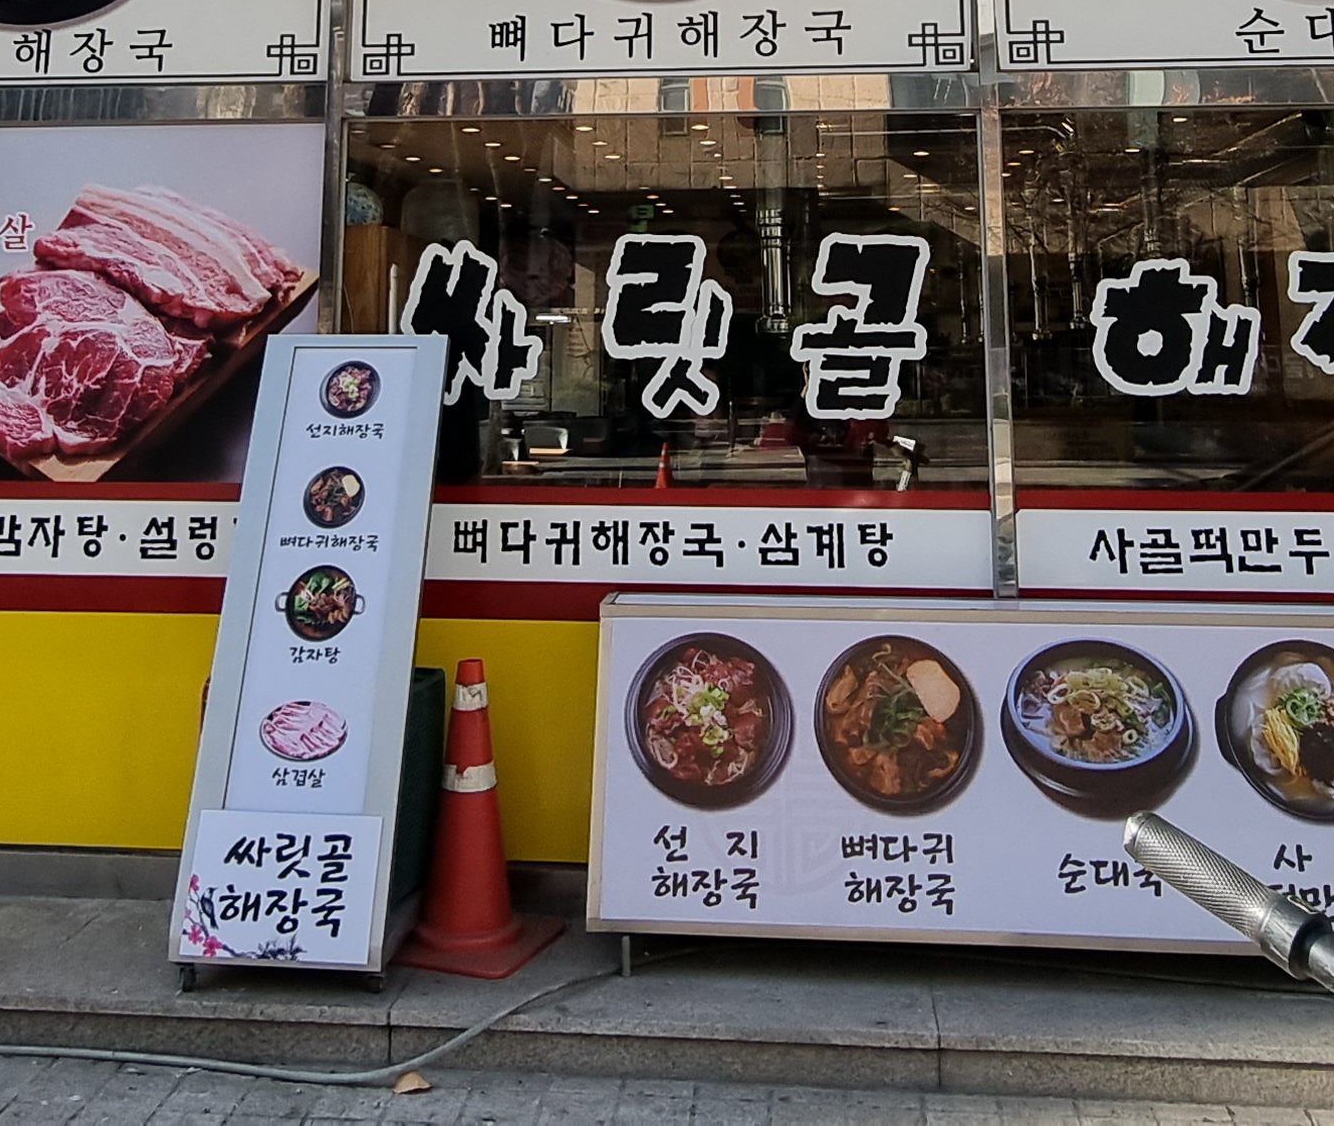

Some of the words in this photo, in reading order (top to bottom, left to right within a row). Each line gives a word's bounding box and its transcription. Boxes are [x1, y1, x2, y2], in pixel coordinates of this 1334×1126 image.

[489, 10, 851, 61] 뼈다귀해장국
[402, 233, 930, 420] 싸릿골
[306, 424, 384, 439] 선지해장국
[280, 535, 378, 552] 뼈다귀해장국
[290, 646, 340, 664] 감자탕
[272, 768, 325, 788] 삼겹살
[223, 832, 354, 884] 싸릿골
[842, 833, 953, 864] 뼈다귀
[652, 866, 759, 909] 해장국
[845, 872, 955, 915] 해장국
[218, 888, 348, 938] 해장국
